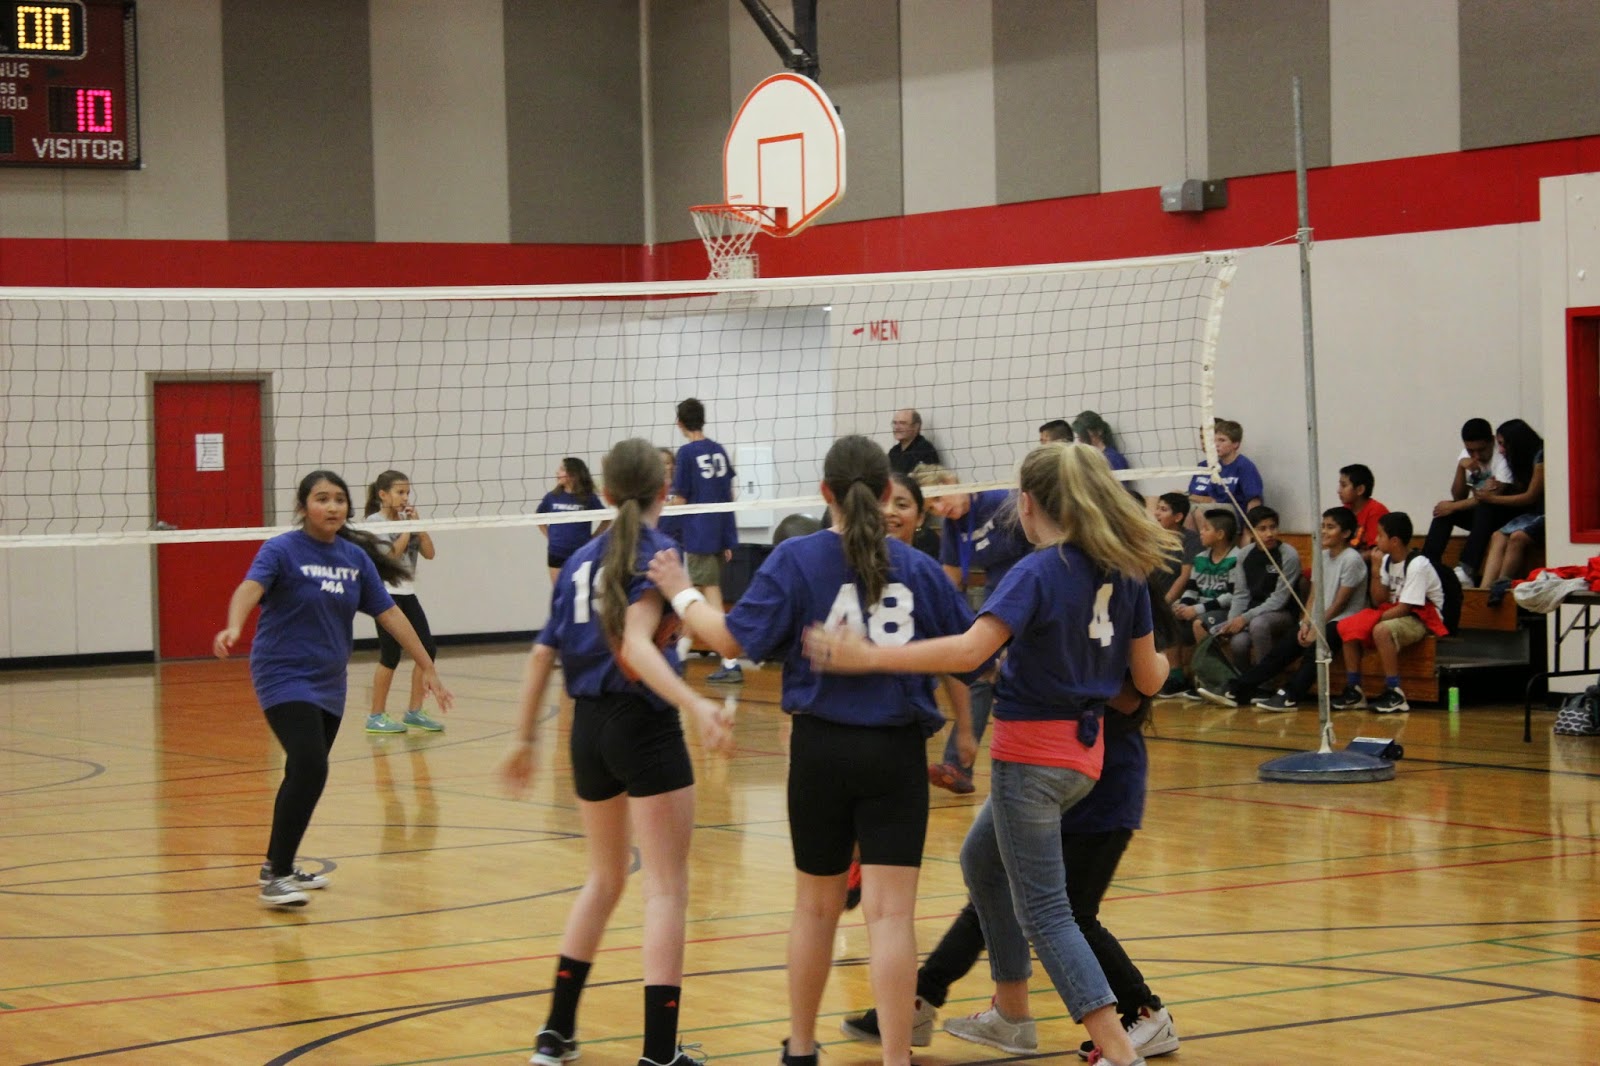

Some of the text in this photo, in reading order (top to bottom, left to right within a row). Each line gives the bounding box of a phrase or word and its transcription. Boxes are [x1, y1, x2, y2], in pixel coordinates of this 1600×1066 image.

[17, 6, 70, 50] 00
[76, 89, 112, 132] 10
[32, 138, 124, 160] VISITOR
[870, 320, 898, 341] MEN
[696, 453, 727, 479] 50
[823, 582, 915, 648] 48
[1088, 583, 1115, 647] 4
